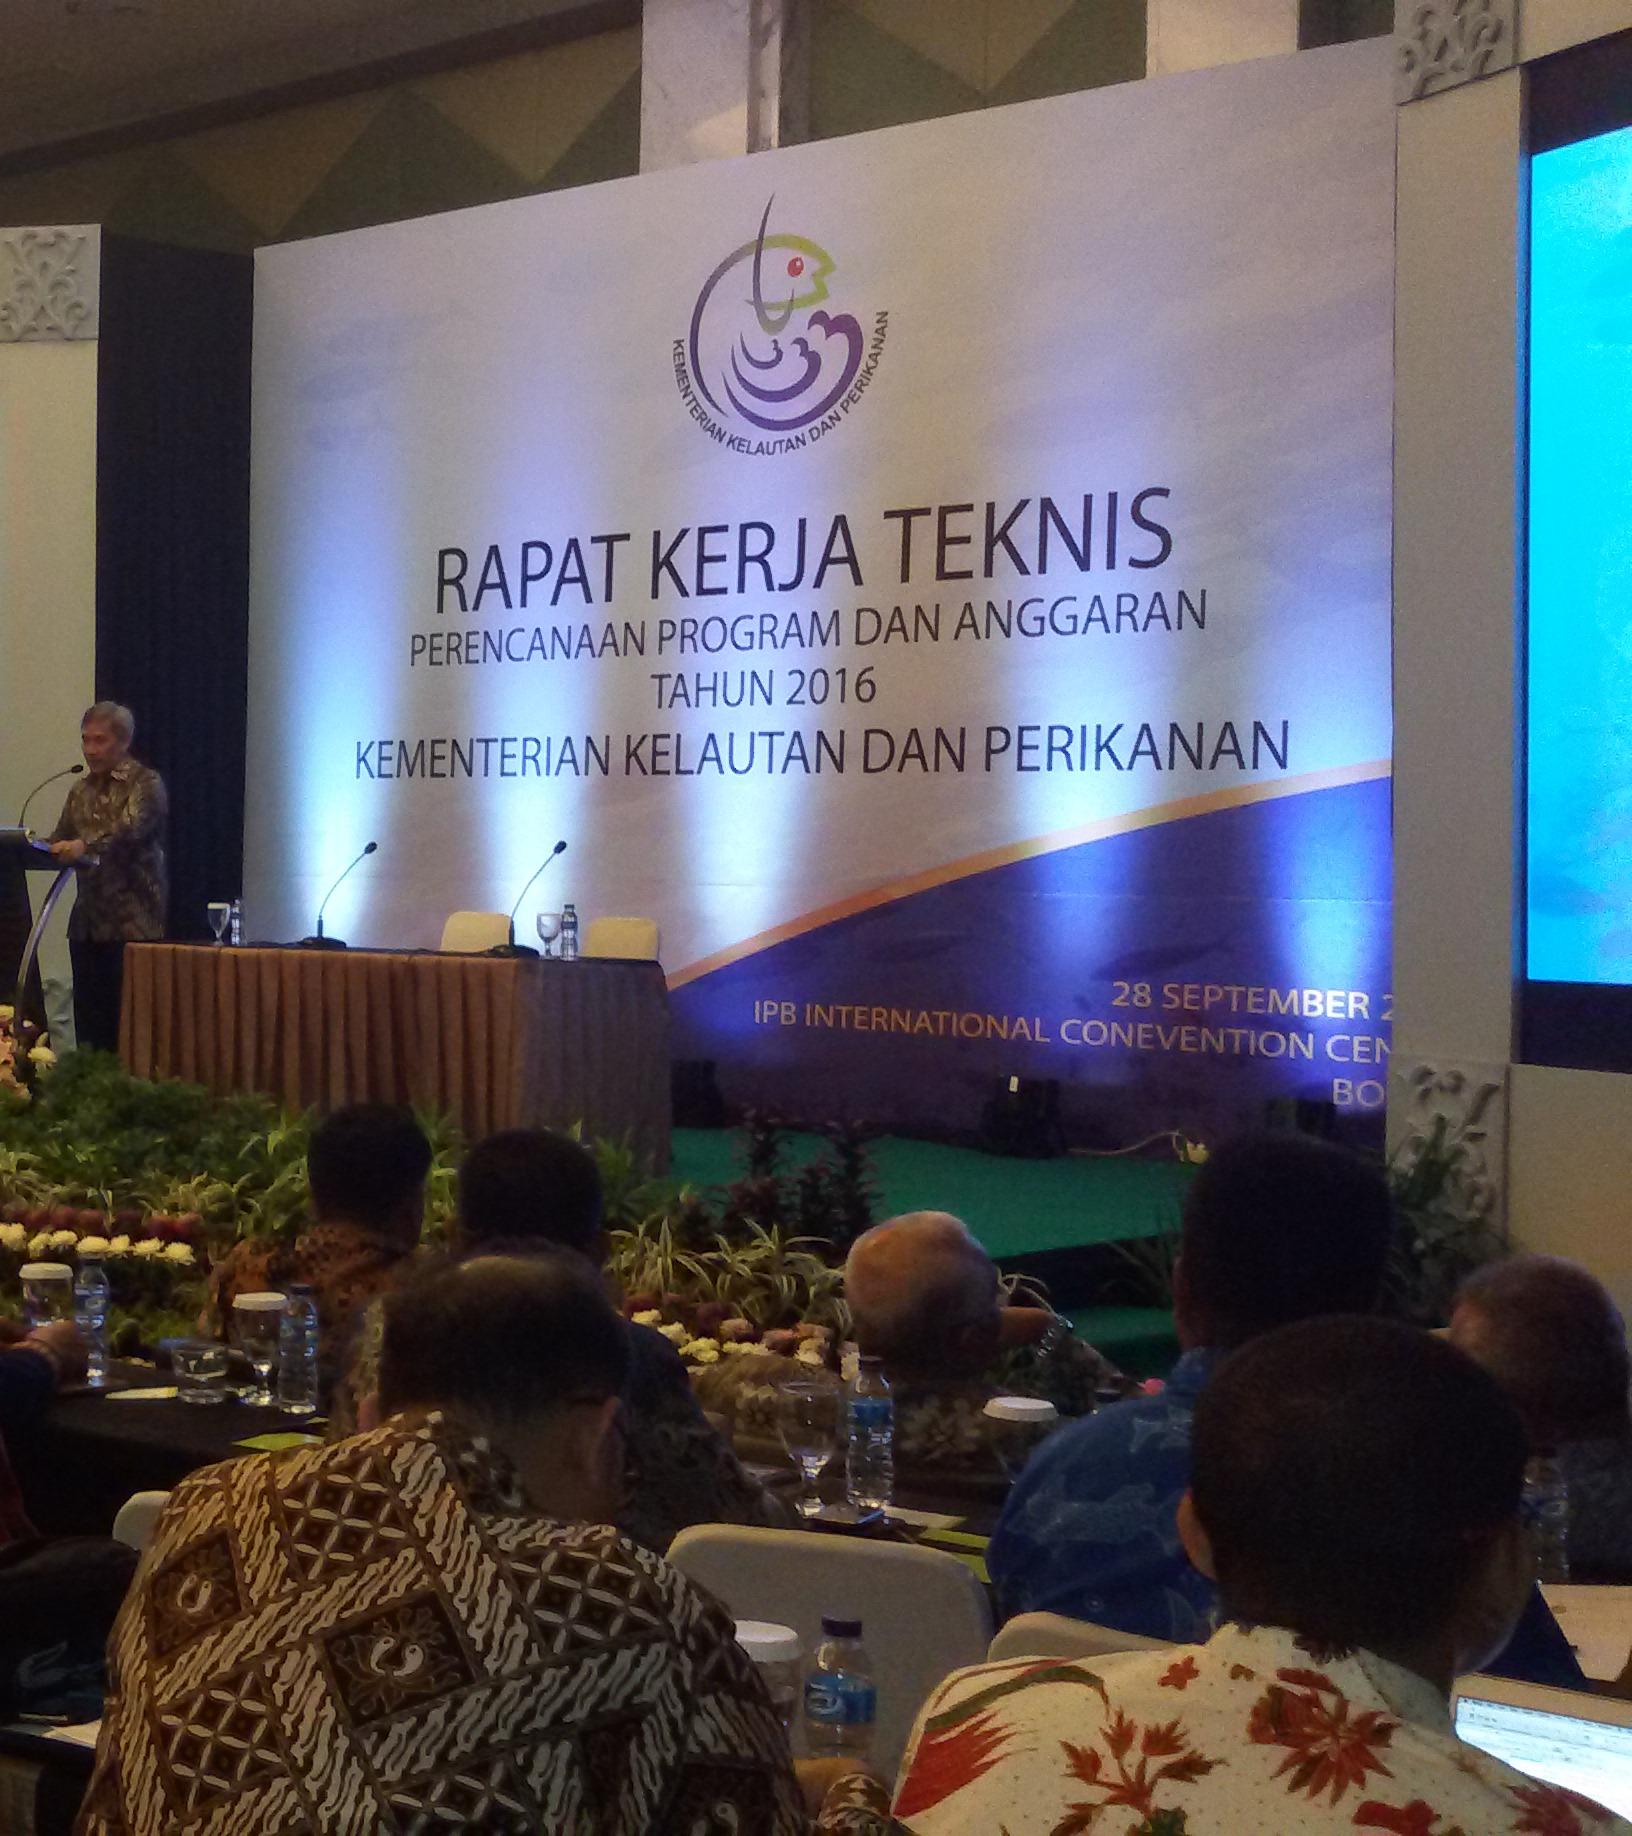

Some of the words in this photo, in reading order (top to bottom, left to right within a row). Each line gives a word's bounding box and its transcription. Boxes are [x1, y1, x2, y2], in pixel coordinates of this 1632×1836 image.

[672, 338, 727, 444] KEMENTERIAN
[726, 432, 807, 456] KELAUTAN
[809, 411, 842, 442] DAN
[840, 310, 889, 414] PERIKANAN
[436, 532, 631, 614] RAPAT
[651, 514, 864, 600] KERJA
[884, 487, 1173, 583] TEKNIS
[410, 620, 646, 667] PERENCANAAN
[657, 609, 841, 656] PROGRAM
[854, 603, 940, 646] DAN
[954, 589, 1208, 641] ANGGARAN
[650, 668, 774, 709] TAHUN
[786, 666, 877, 706] 2016
[355, 735, 610, 780] KEMENTERIAN
[624, 729, 845, 777] KELAUTAN
[862, 726, 966, 774] DAN
[985, 720, 1289, 773] PERIKANAN
[753, 1000, 797, 1025] IPB
[805, 1003, 1050, 1043] INTERNATIONAL
[1060, 1019, 1314, 1060] CONEVENTION
[1325, 1034, 1392, 1065] CEN
[1112, 981, 1153, 1009] 28
[1162, 982, 1371, 1020] SEPTEMBER
